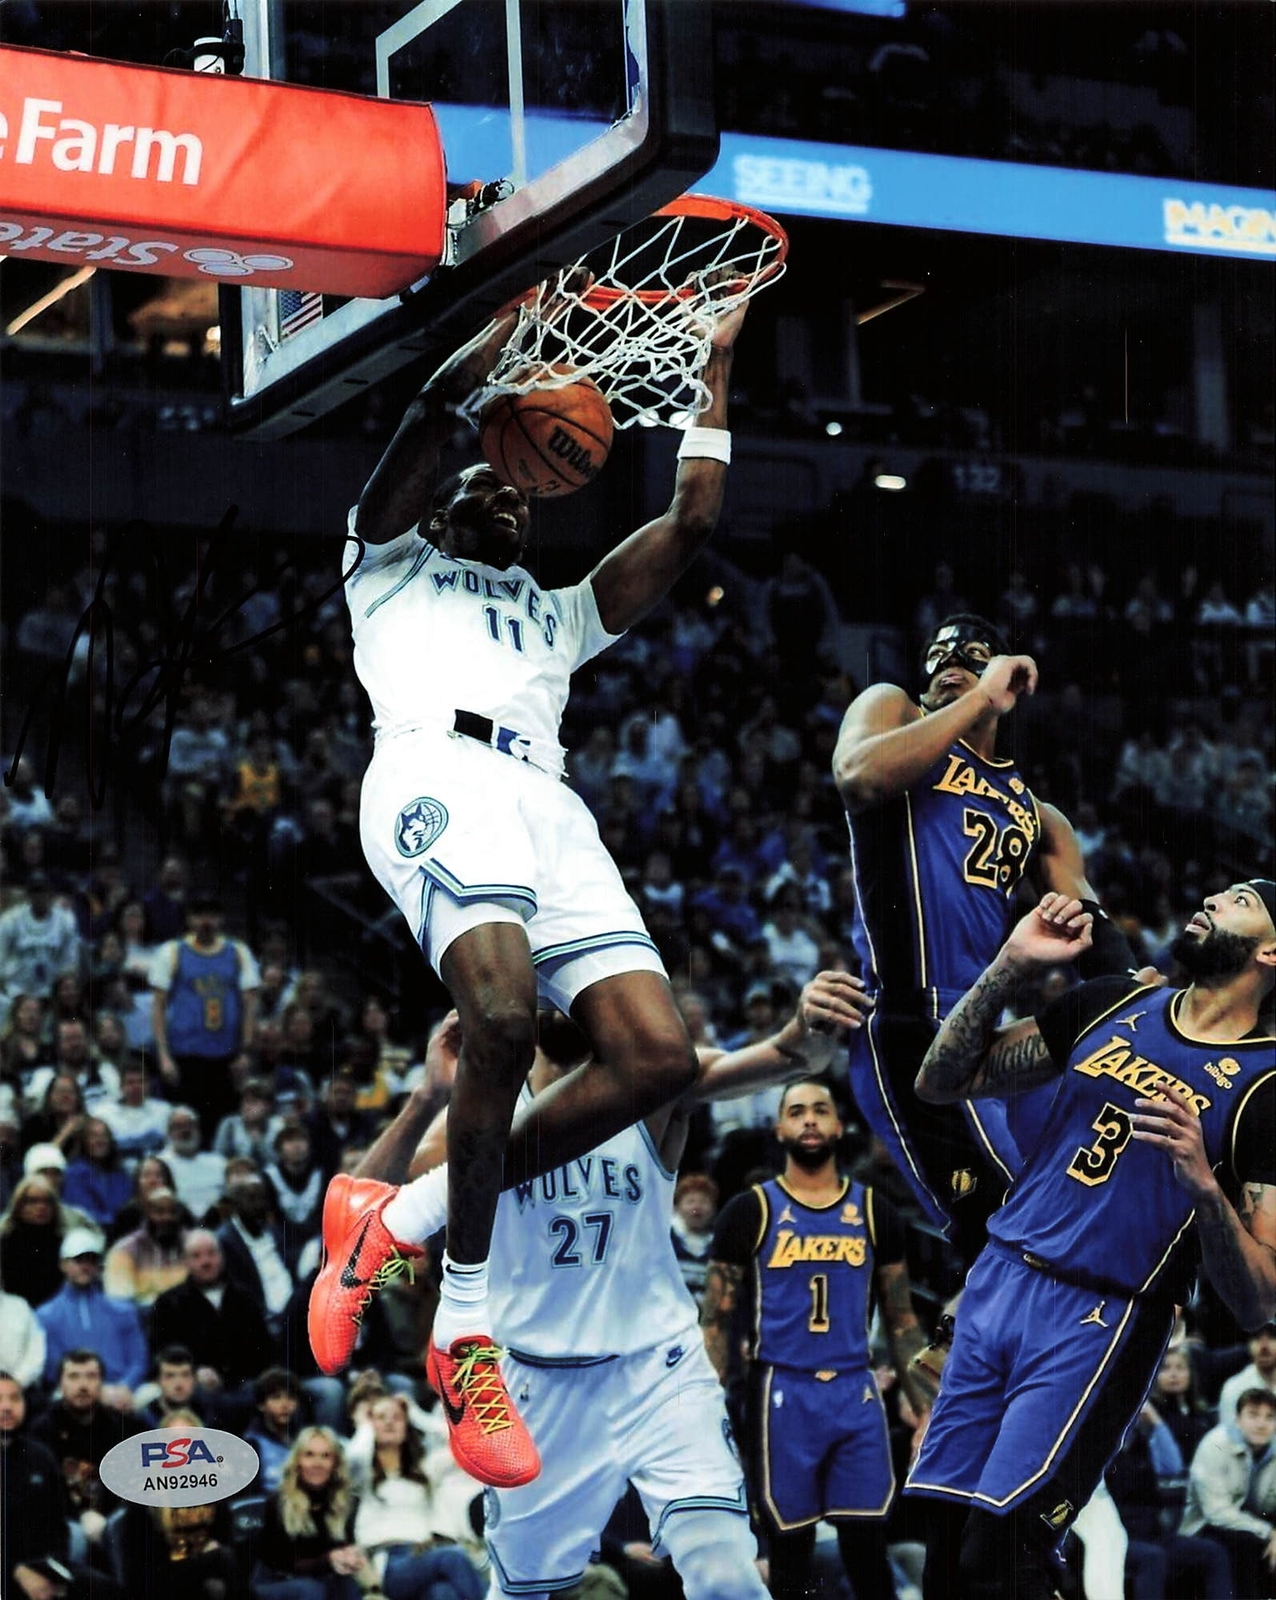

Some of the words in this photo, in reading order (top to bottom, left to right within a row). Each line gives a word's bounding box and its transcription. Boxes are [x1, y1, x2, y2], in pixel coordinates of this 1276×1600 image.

[15, 97, 203, 186] Farm
[430, 568, 557, 649] WOLVES
[482, 603, 524, 652] 11
[963, 808, 1032, 899] 28
[1066, 1102, 1134, 1186] 3
[548, 1211, 614, 1268] 27
[767, 1230, 867, 1267] LAKERS
[809, 1274, 830, 1332] 1
